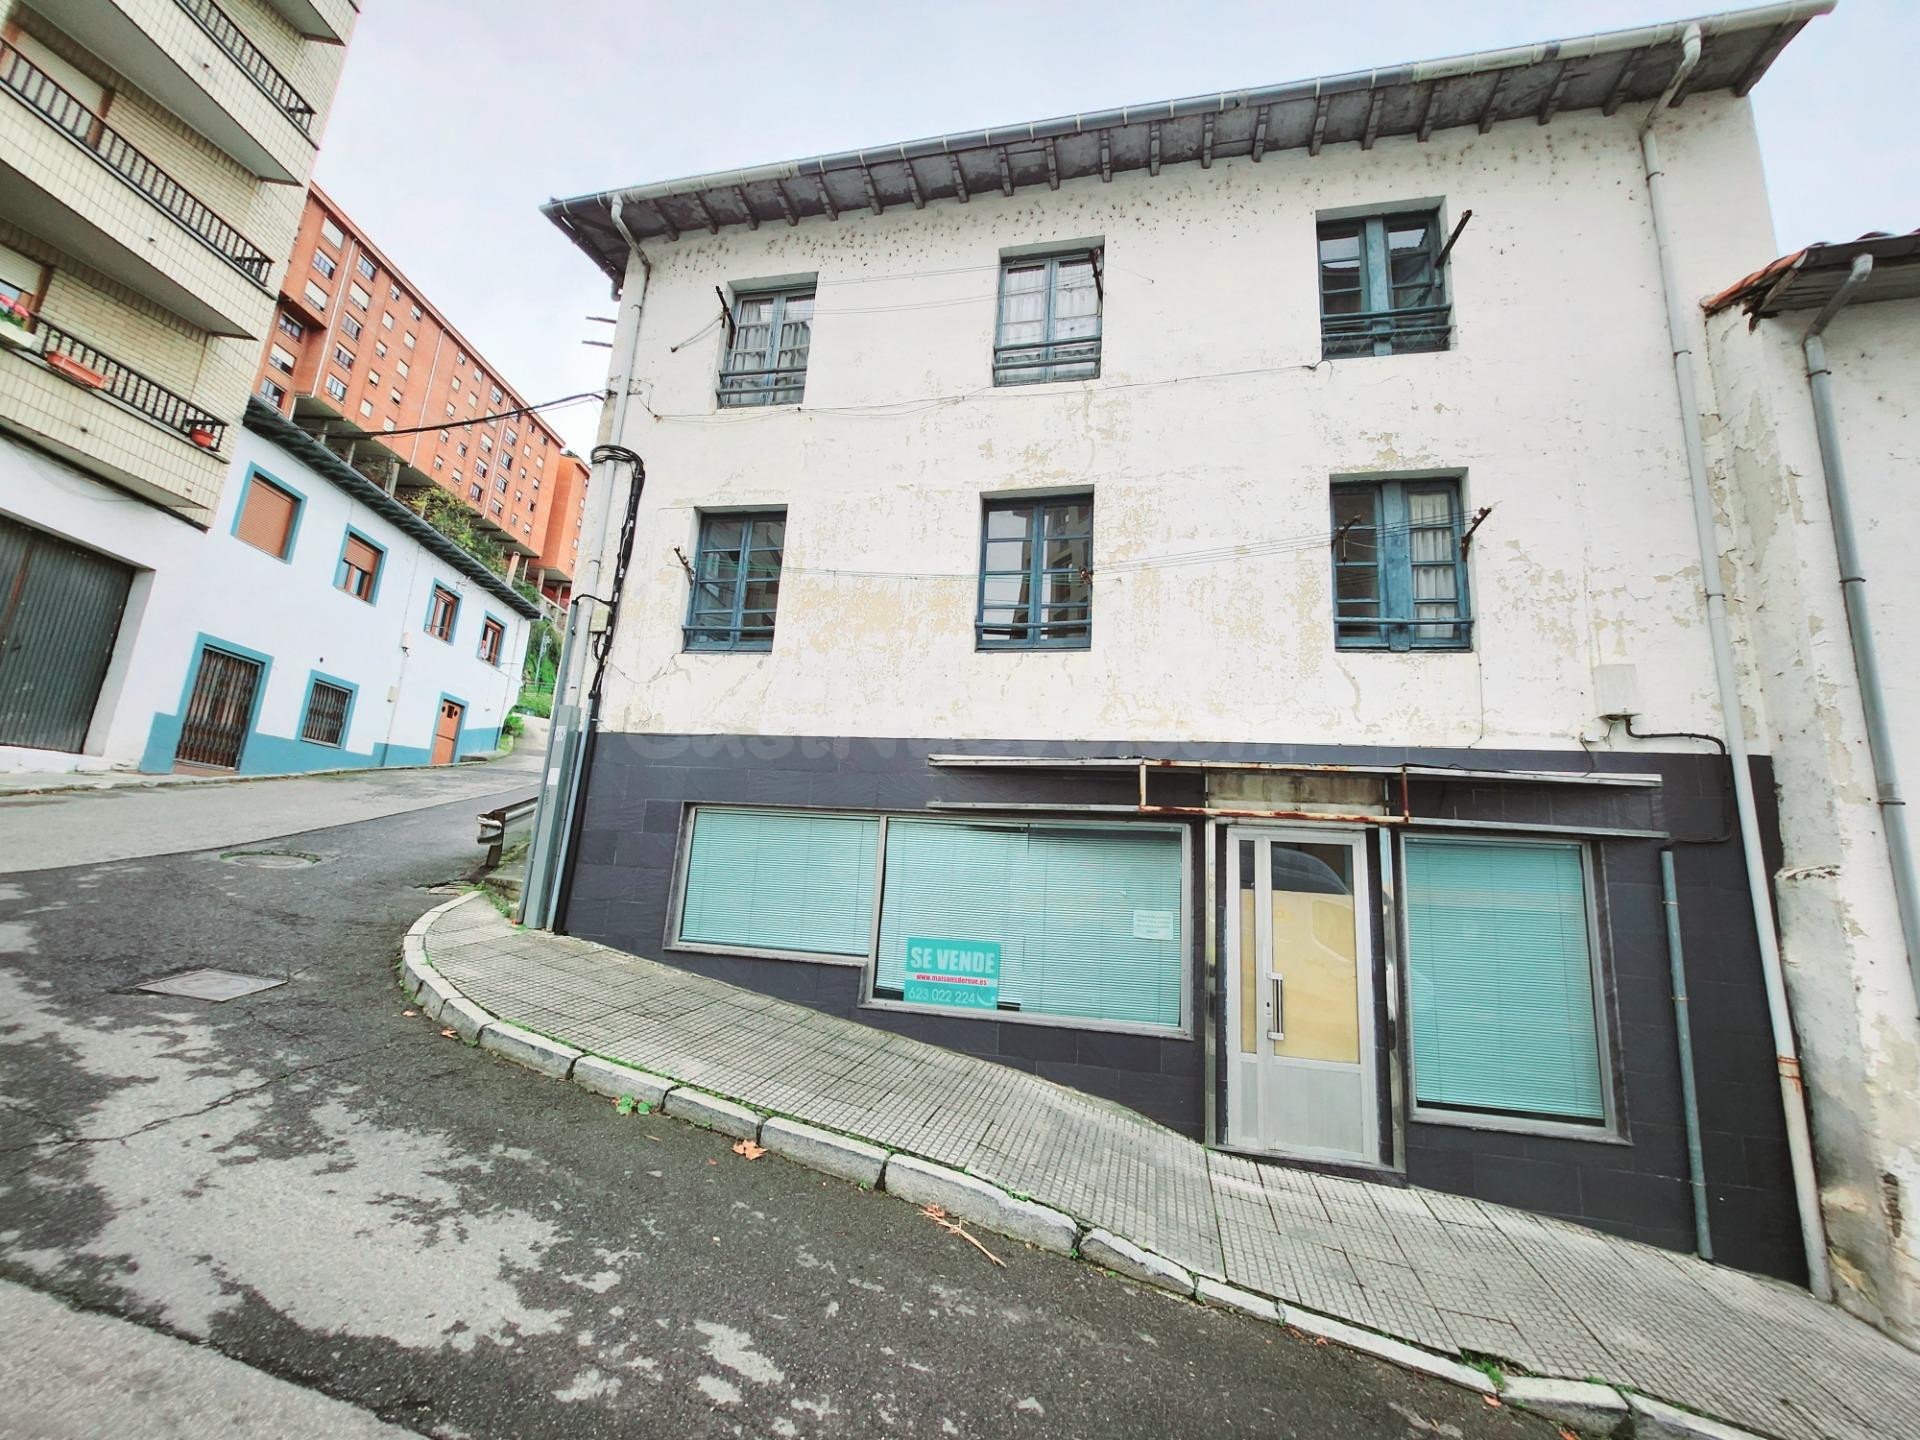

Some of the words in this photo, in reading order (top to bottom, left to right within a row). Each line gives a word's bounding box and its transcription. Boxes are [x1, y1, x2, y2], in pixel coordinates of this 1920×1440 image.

[910, 947, 932, 969] SE
[936, 949, 994, 974] VENDE
[908, 987, 929, 1000] 623
[932, 989, 952, 1002] 022
[955, 991, 976, 1004] 224
